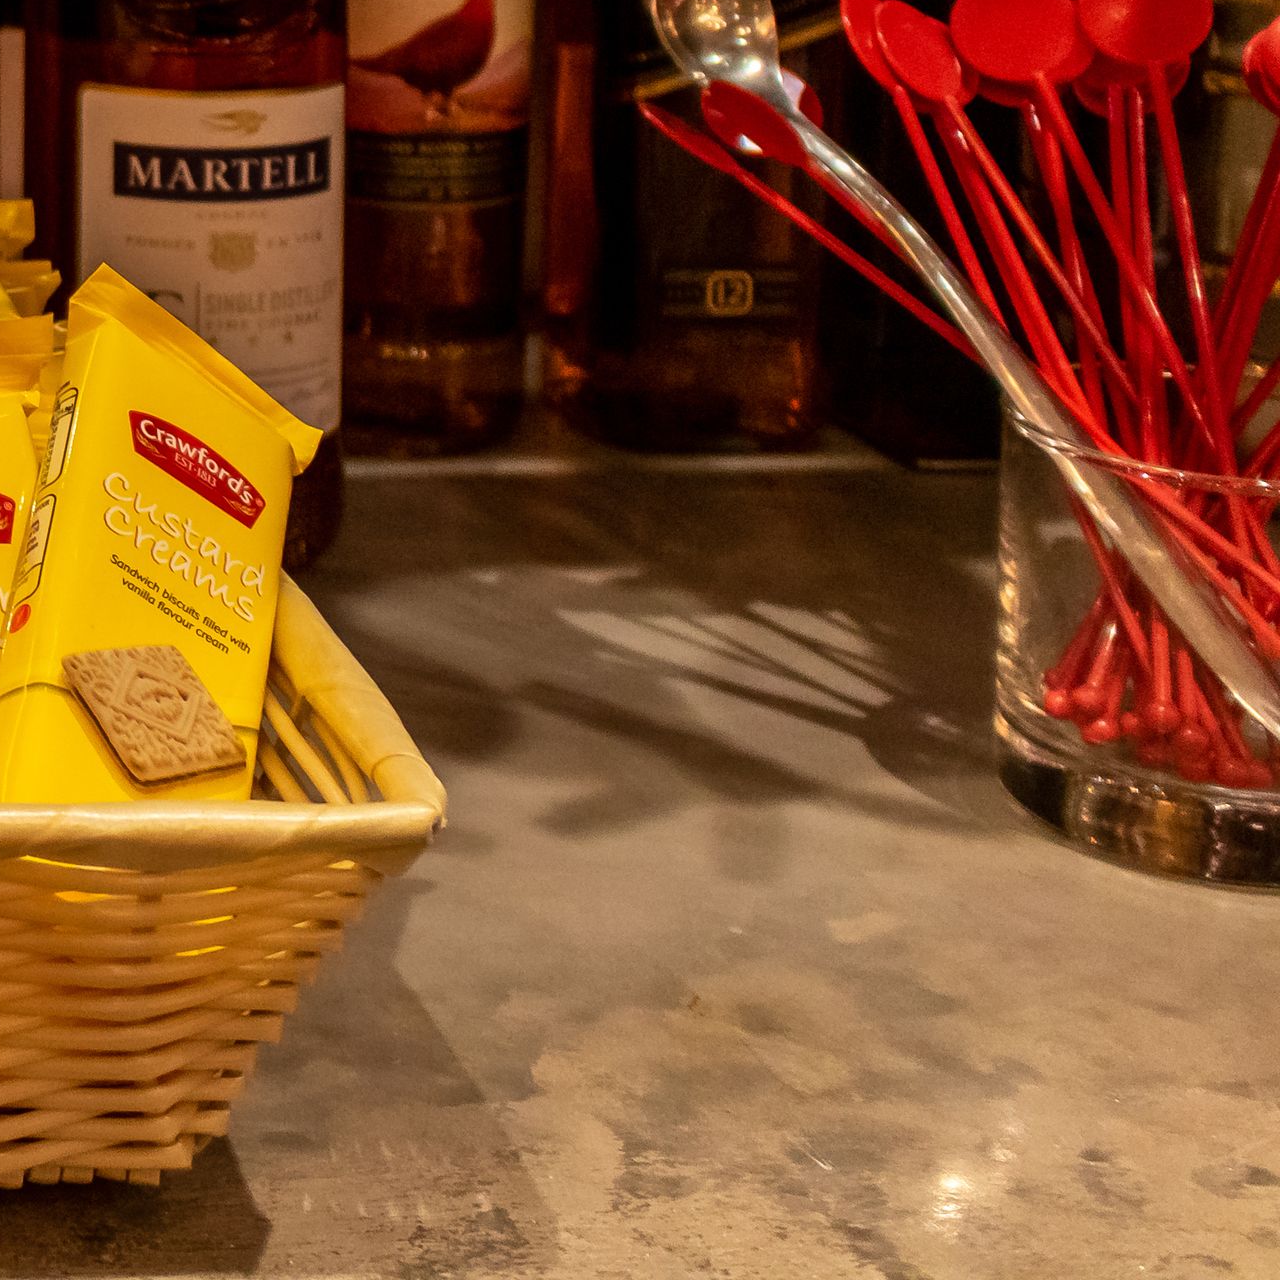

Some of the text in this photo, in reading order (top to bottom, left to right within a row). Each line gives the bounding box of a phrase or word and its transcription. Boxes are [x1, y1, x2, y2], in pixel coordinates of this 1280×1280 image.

[126, 150, 326, 193] MARTELL
[140, 419, 255, 505] Crawford's
[103, 471, 266, 597] Custard
[104, 505, 255, 624] Creams
[110, 553, 252, 656] Sandwich biscuits filled with
[121, 577, 230, 655] vanilla flavour cream
